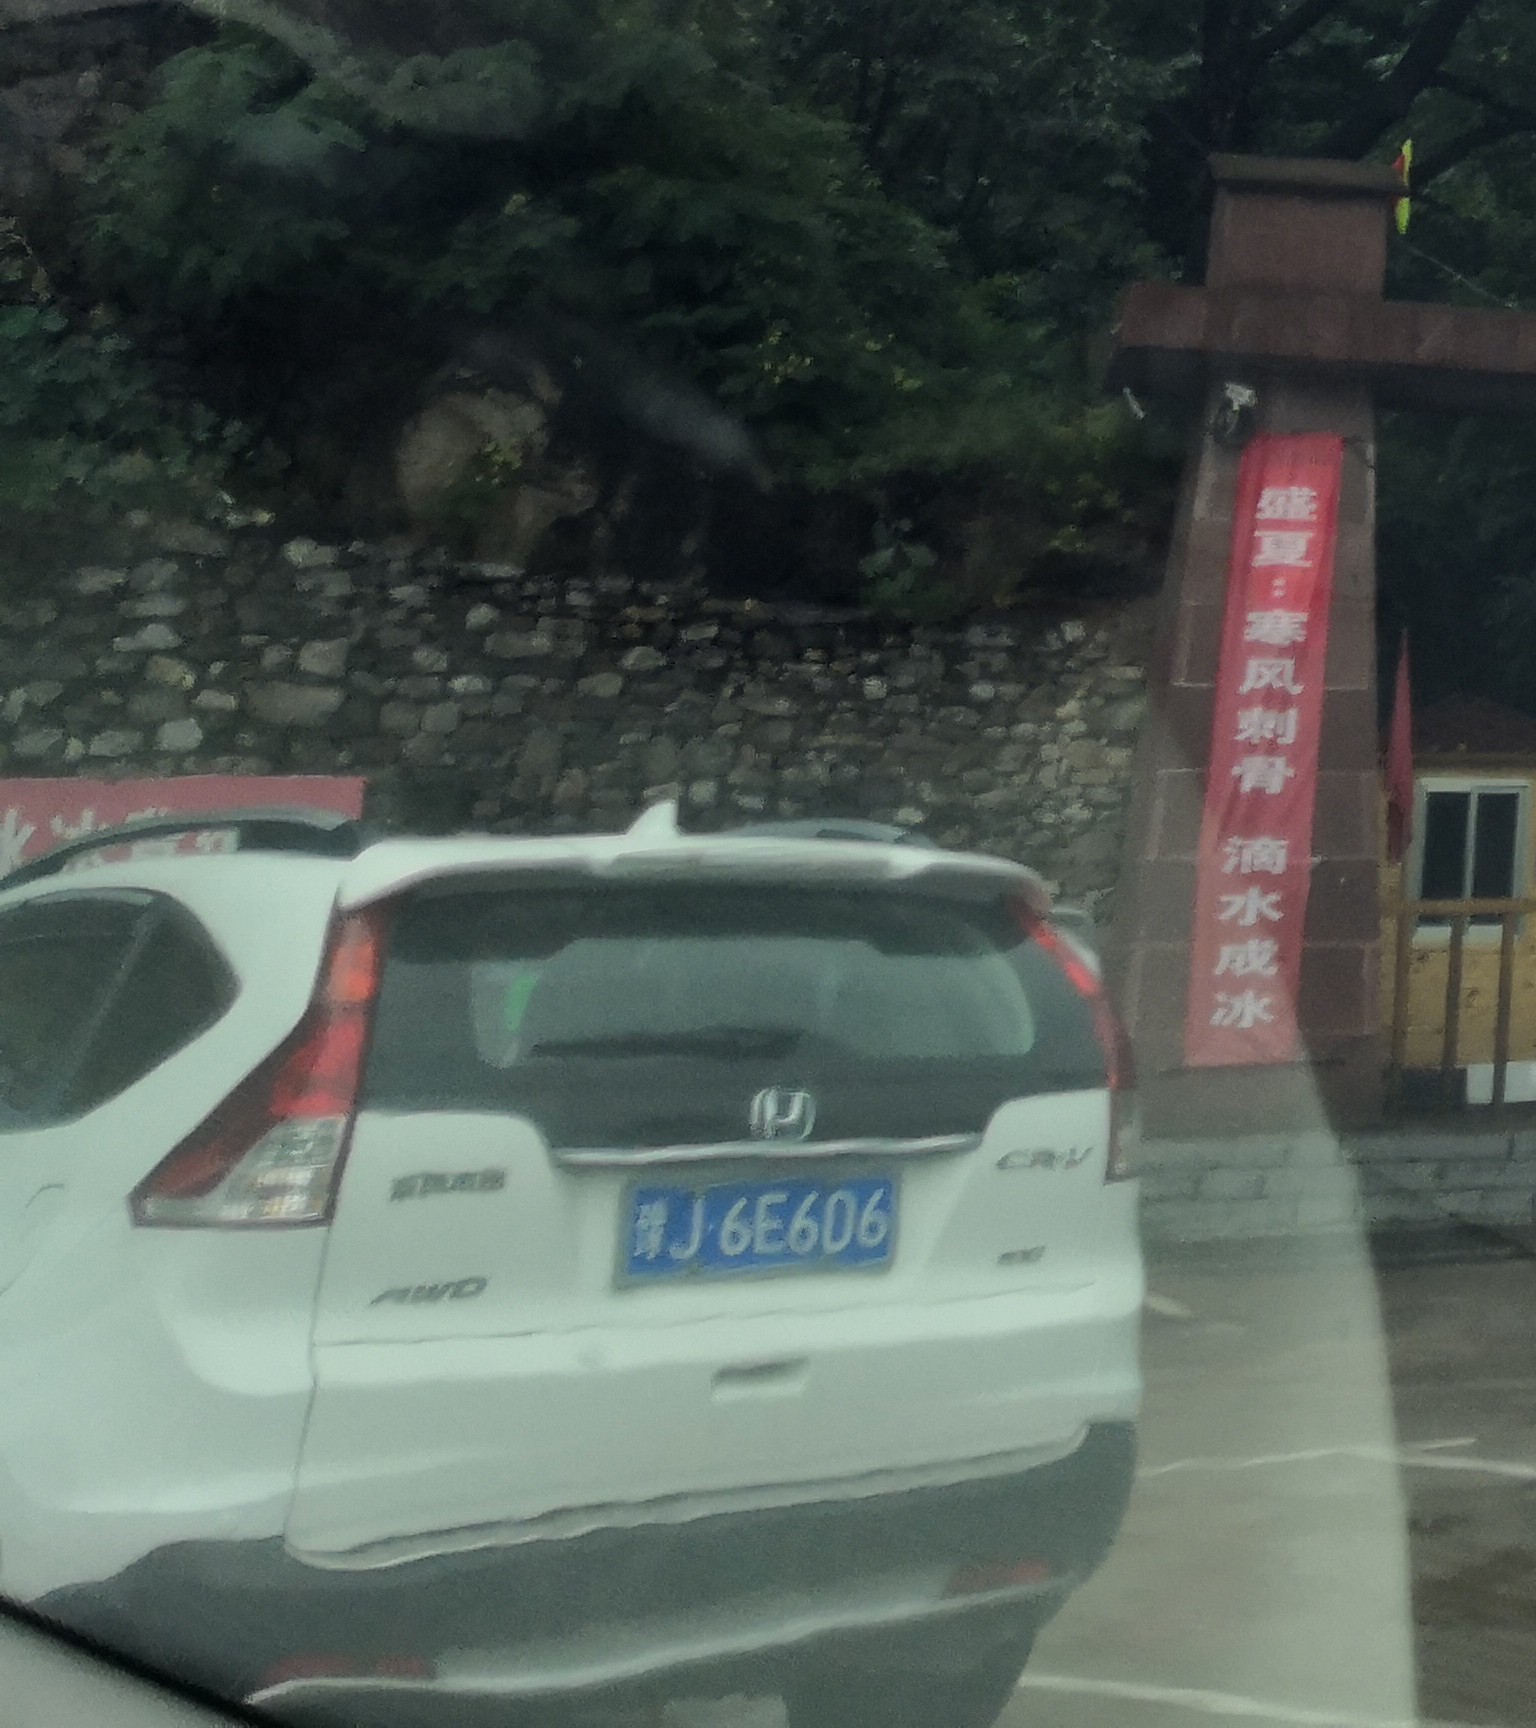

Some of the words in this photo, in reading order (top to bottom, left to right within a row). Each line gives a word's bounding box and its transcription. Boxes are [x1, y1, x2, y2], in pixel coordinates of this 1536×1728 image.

[1209, 836, 1289, 1028] 滴水成冰
[368, 1275, 489, 1306] AWD
